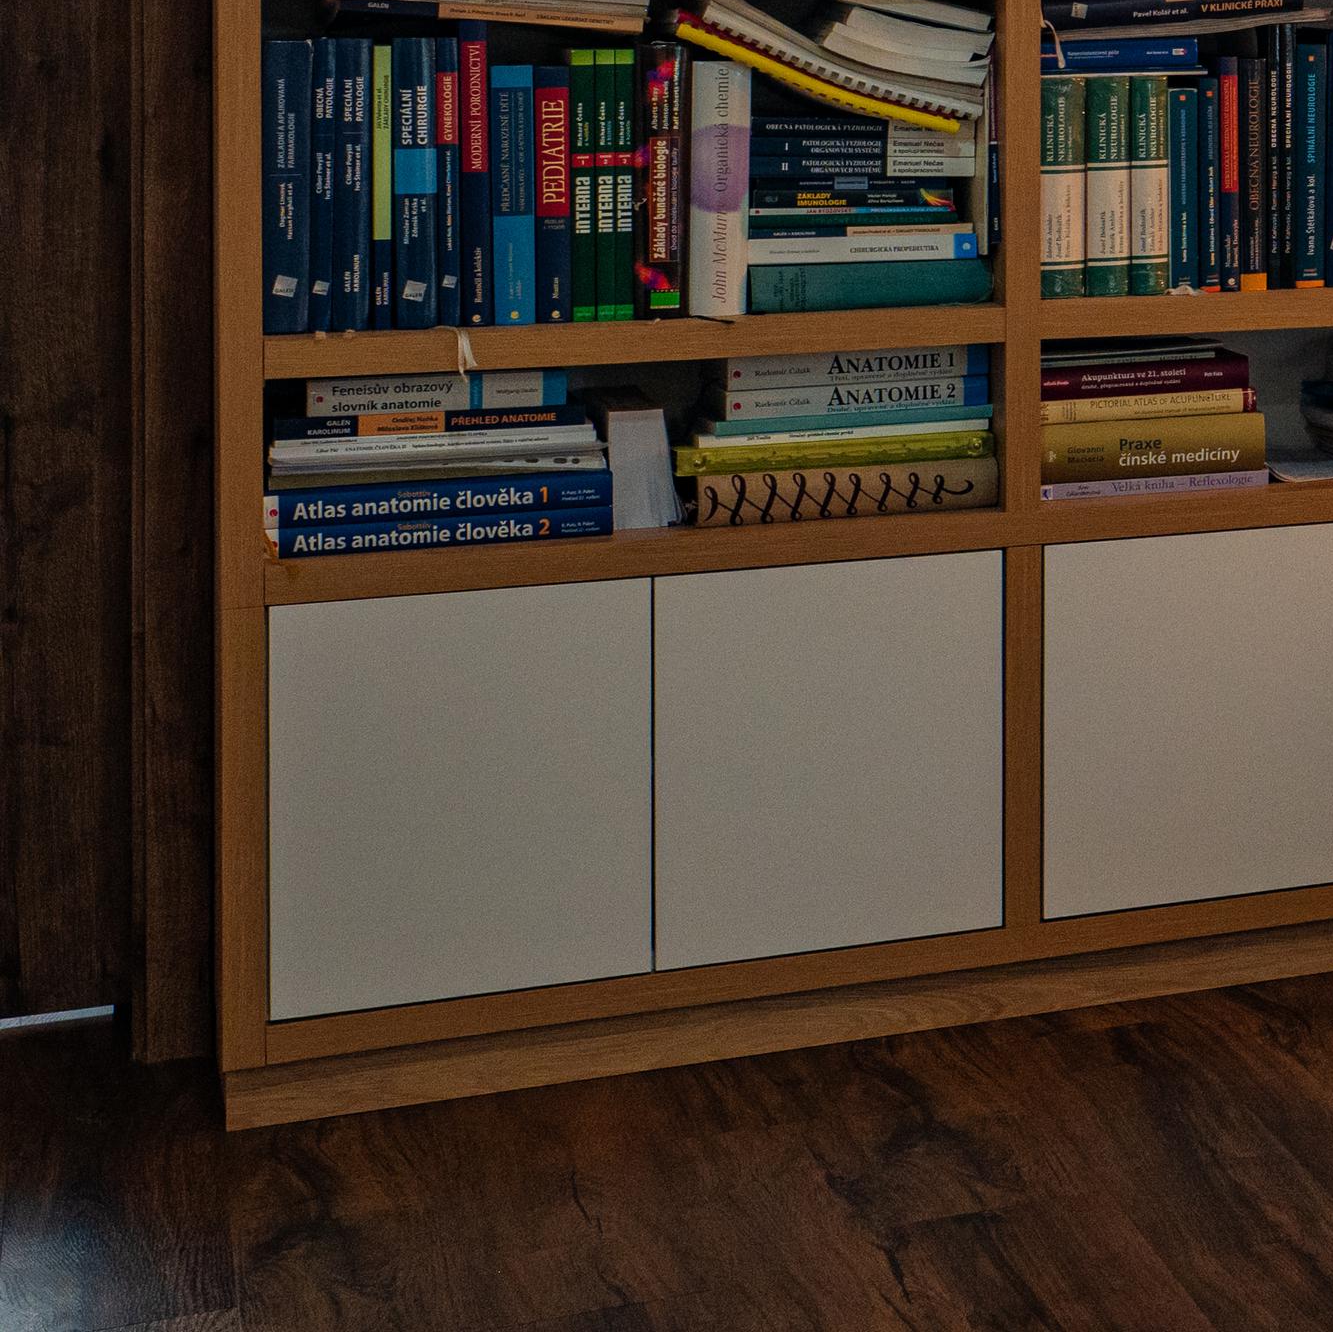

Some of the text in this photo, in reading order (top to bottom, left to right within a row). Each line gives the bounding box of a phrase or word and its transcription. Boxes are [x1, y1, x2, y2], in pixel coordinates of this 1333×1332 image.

[1201, 0, 1283, 13] V KLINICKÉ PRAXI
[315, 88, 324, 119] OBECNÁ
[325, 78, 334, 118] PATOLOGIE
[342, 79, 353, 122] SPECIÁLNÍ
[355, 76, 364, 122] PATOLOGIE
[399, 89, 413, 145] SPECIÁLNÍ
[417, 85, 428, 145] CHIRURGIE
[443, 76, 453, 141] GYNEKOLOGIE
[468, 44, 482, 170] MODERNÍ PORODNICTVÍ
[714, 69, 730, 192] Organická chemie
[1046, 114, 1054, 162] KLINICKÁ
[1110, 96, 1118, 159] NEUROLOGIE
[1306, 74, 1316, 163] SPINÁLNÍ NEUROLOGIE
[542, 100, 566, 204] PEDIATRIE
[652, 140, 668, 259] Základy buněčné biologie
[826, 353, 955, 375] ANATOMIE 1
[1081, 371, 1135, 382] Akupunktura
[1160, 368, 1186, 377] století
[332, 381, 453, 397] Feneisův obrazový
[332, 398, 441, 412] slovník anatomie
[826, 383, 956, 406] ANATOMIE 2
[450, 412, 557, 426] PŘEHLED ANATOMIE
[1119, 448, 1240, 467] čínské medicíny
[1120, 439, 1162, 451] Praxe
[293, 486, 549, 521] Atlas anatomie člověka 1
[293, 518, 551, 553] Atlas anatomie člověka 2
